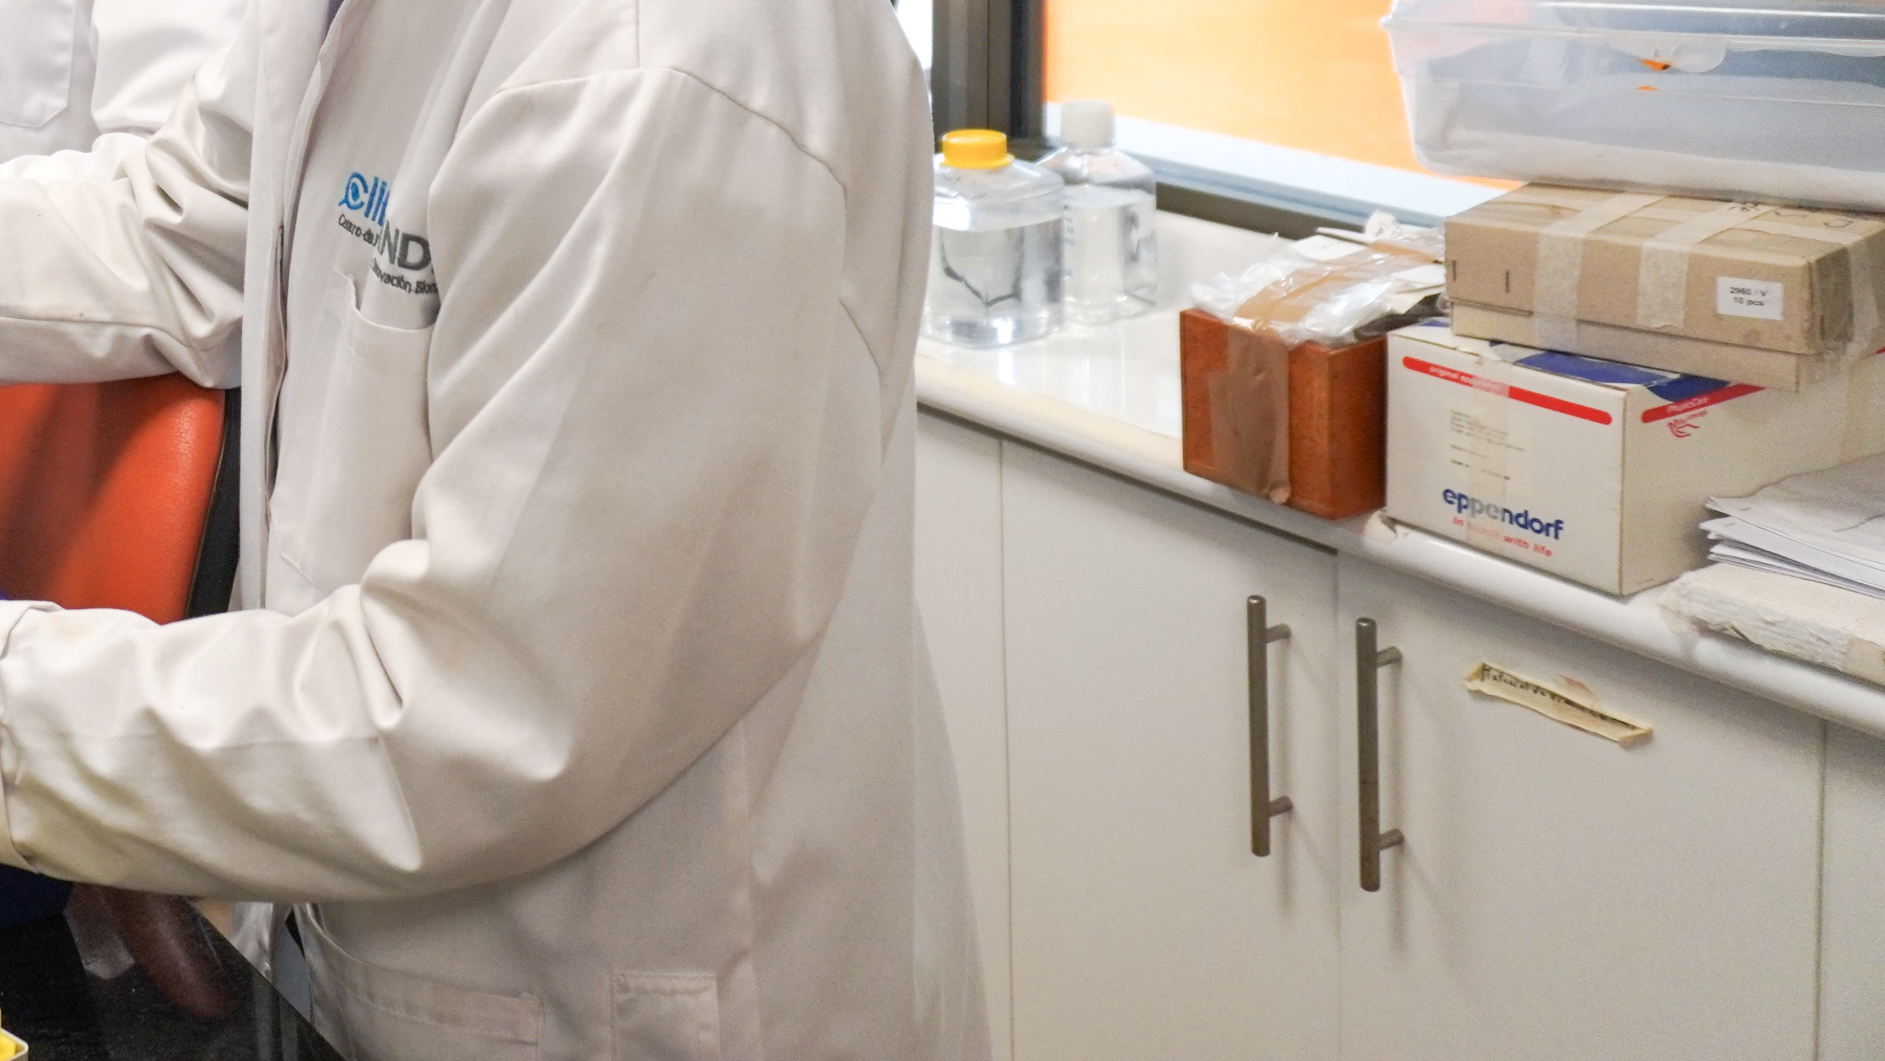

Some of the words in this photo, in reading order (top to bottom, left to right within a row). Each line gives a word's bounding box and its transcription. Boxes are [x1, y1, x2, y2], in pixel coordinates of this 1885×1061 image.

[1442, 488, 1564, 540] eppendorf
[1504, 535, 1530, 550] with
[1533, 542, 1553, 557] life
